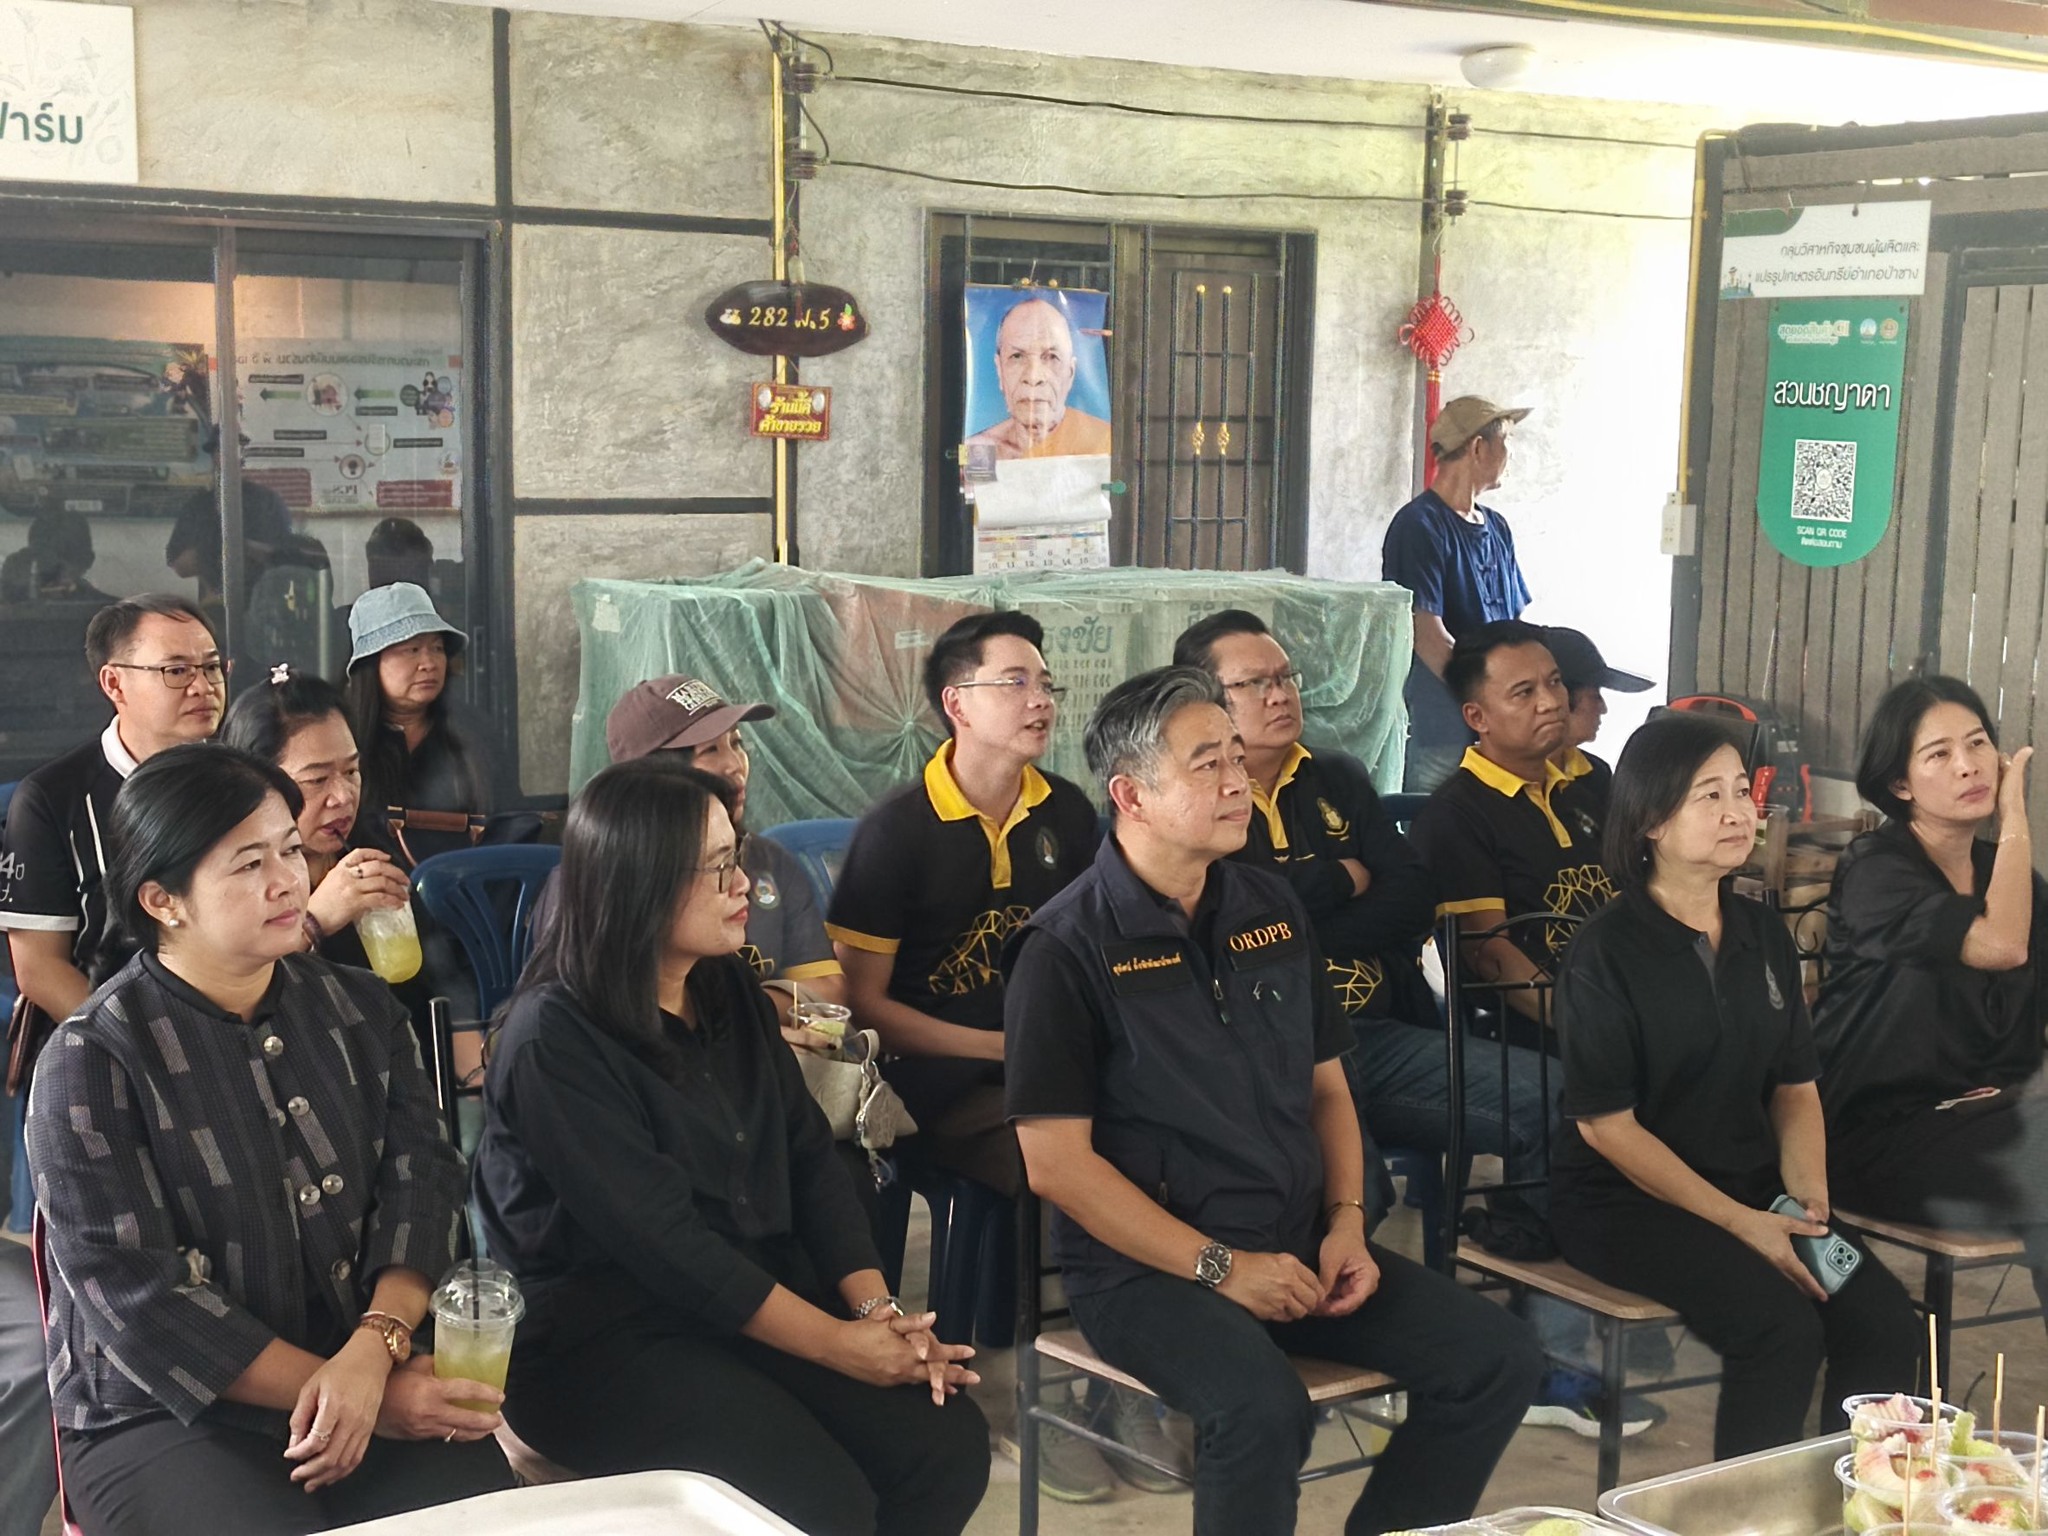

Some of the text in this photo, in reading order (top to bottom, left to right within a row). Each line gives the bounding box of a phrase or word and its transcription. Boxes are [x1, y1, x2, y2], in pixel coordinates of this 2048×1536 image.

[0, 101, 83, 144] าร์ม
[748, 307, 788, 327] 282
[1774, 380, 1891, 411] สวนชญาดา
[1797, 525, 1847, 539] SCAN QR CODE
[1229, 922, 1292, 951] ORDPB
